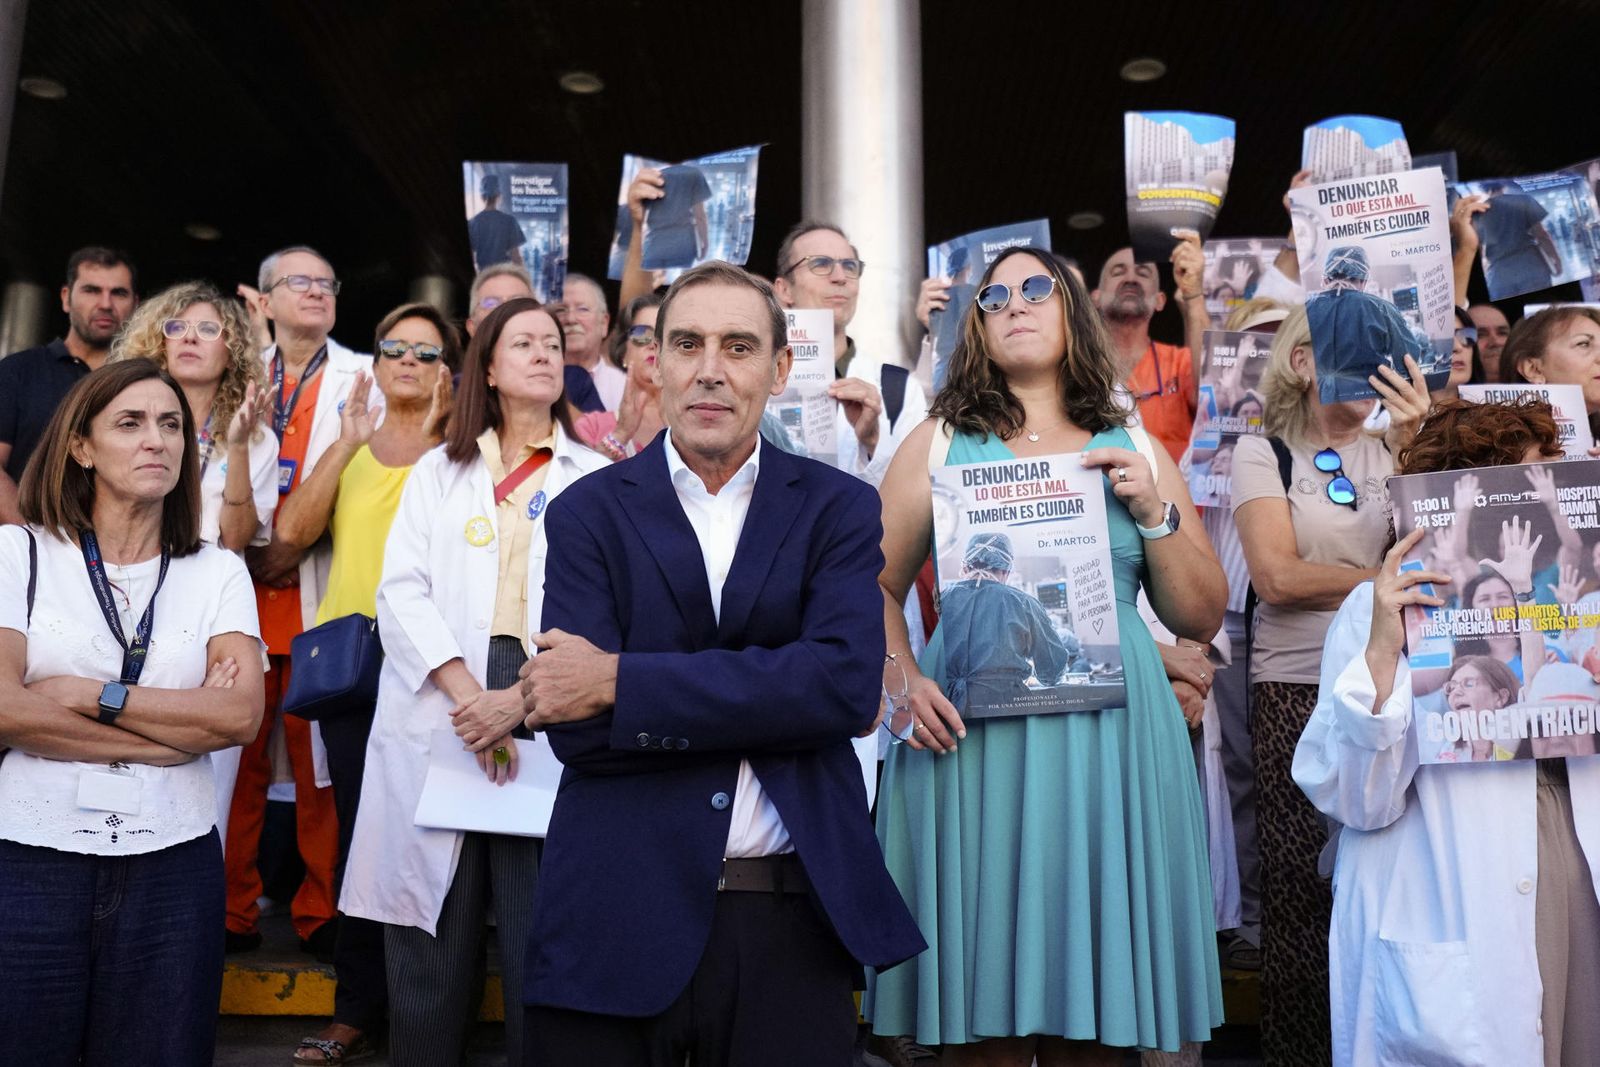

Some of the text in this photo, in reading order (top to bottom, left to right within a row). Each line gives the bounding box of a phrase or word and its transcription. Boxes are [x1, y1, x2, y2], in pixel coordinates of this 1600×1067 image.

[511, 176, 553, 188] Investigar
[511, 186, 524, 195] los
[1318, 178, 1399, 205] DENUNCIAR
[1331, 193, 1416, 218] LO QUE ESTÁ MAL
[1325, 210, 1430, 240] TAMBIÉN ES CUIDAR
[1405, 243, 1441, 255] MARTOS
[790, 329, 808, 339] MAL
[792, 345, 819, 358] IDAR
[794, 373, 826, 381] MARTOS
[1551, 406, 1563, 417] AL
[962, 461, 1051, 487] DENUNCIAR
[975, 479, 1069, 501] LO QUE ESTÁ MAL
[967, 498, 1085, 525] TAMBIÉN ES CUIDAR
[1412, 496, 1450, 513] 11:00 H
[1414, 512, 1456, 528] 24 SEPT
[1567, 515, 1600, 530] CAJAL
[1038, 536, 1097, 548] Dr. MARTOS
[1072, 559, 1100, 576] SANIDAD
[1074, 579, 1106, 600] DE CALIDAD
[1078, 591, 1108, 609] PARA TODAS
[1078, 602, 1112, 621] LAS PERSONAS
[1432, 610, 1445, 623] EN
[1448, 608, 1482, 623] APOYO
[1484, 608, 1491, 621] A
[1493, 606, 1516, 621] LUIS
[1519, 604, 1560, 619] MARTOS
[1561, 603, 1568, 617] Y
[1570, 602, 1589, 616] POR
[1420, 620, 1495, 637] TRASPARENCIA
[1497, 620, 1510, 633] DE
[1512, 618, 1532, 633] LAS
[1533, 615, 1565, 631] LISTAS
[1567, 615, 1579, 629] DE
[1013, 694, 1058, 702] PROFESIONALES
